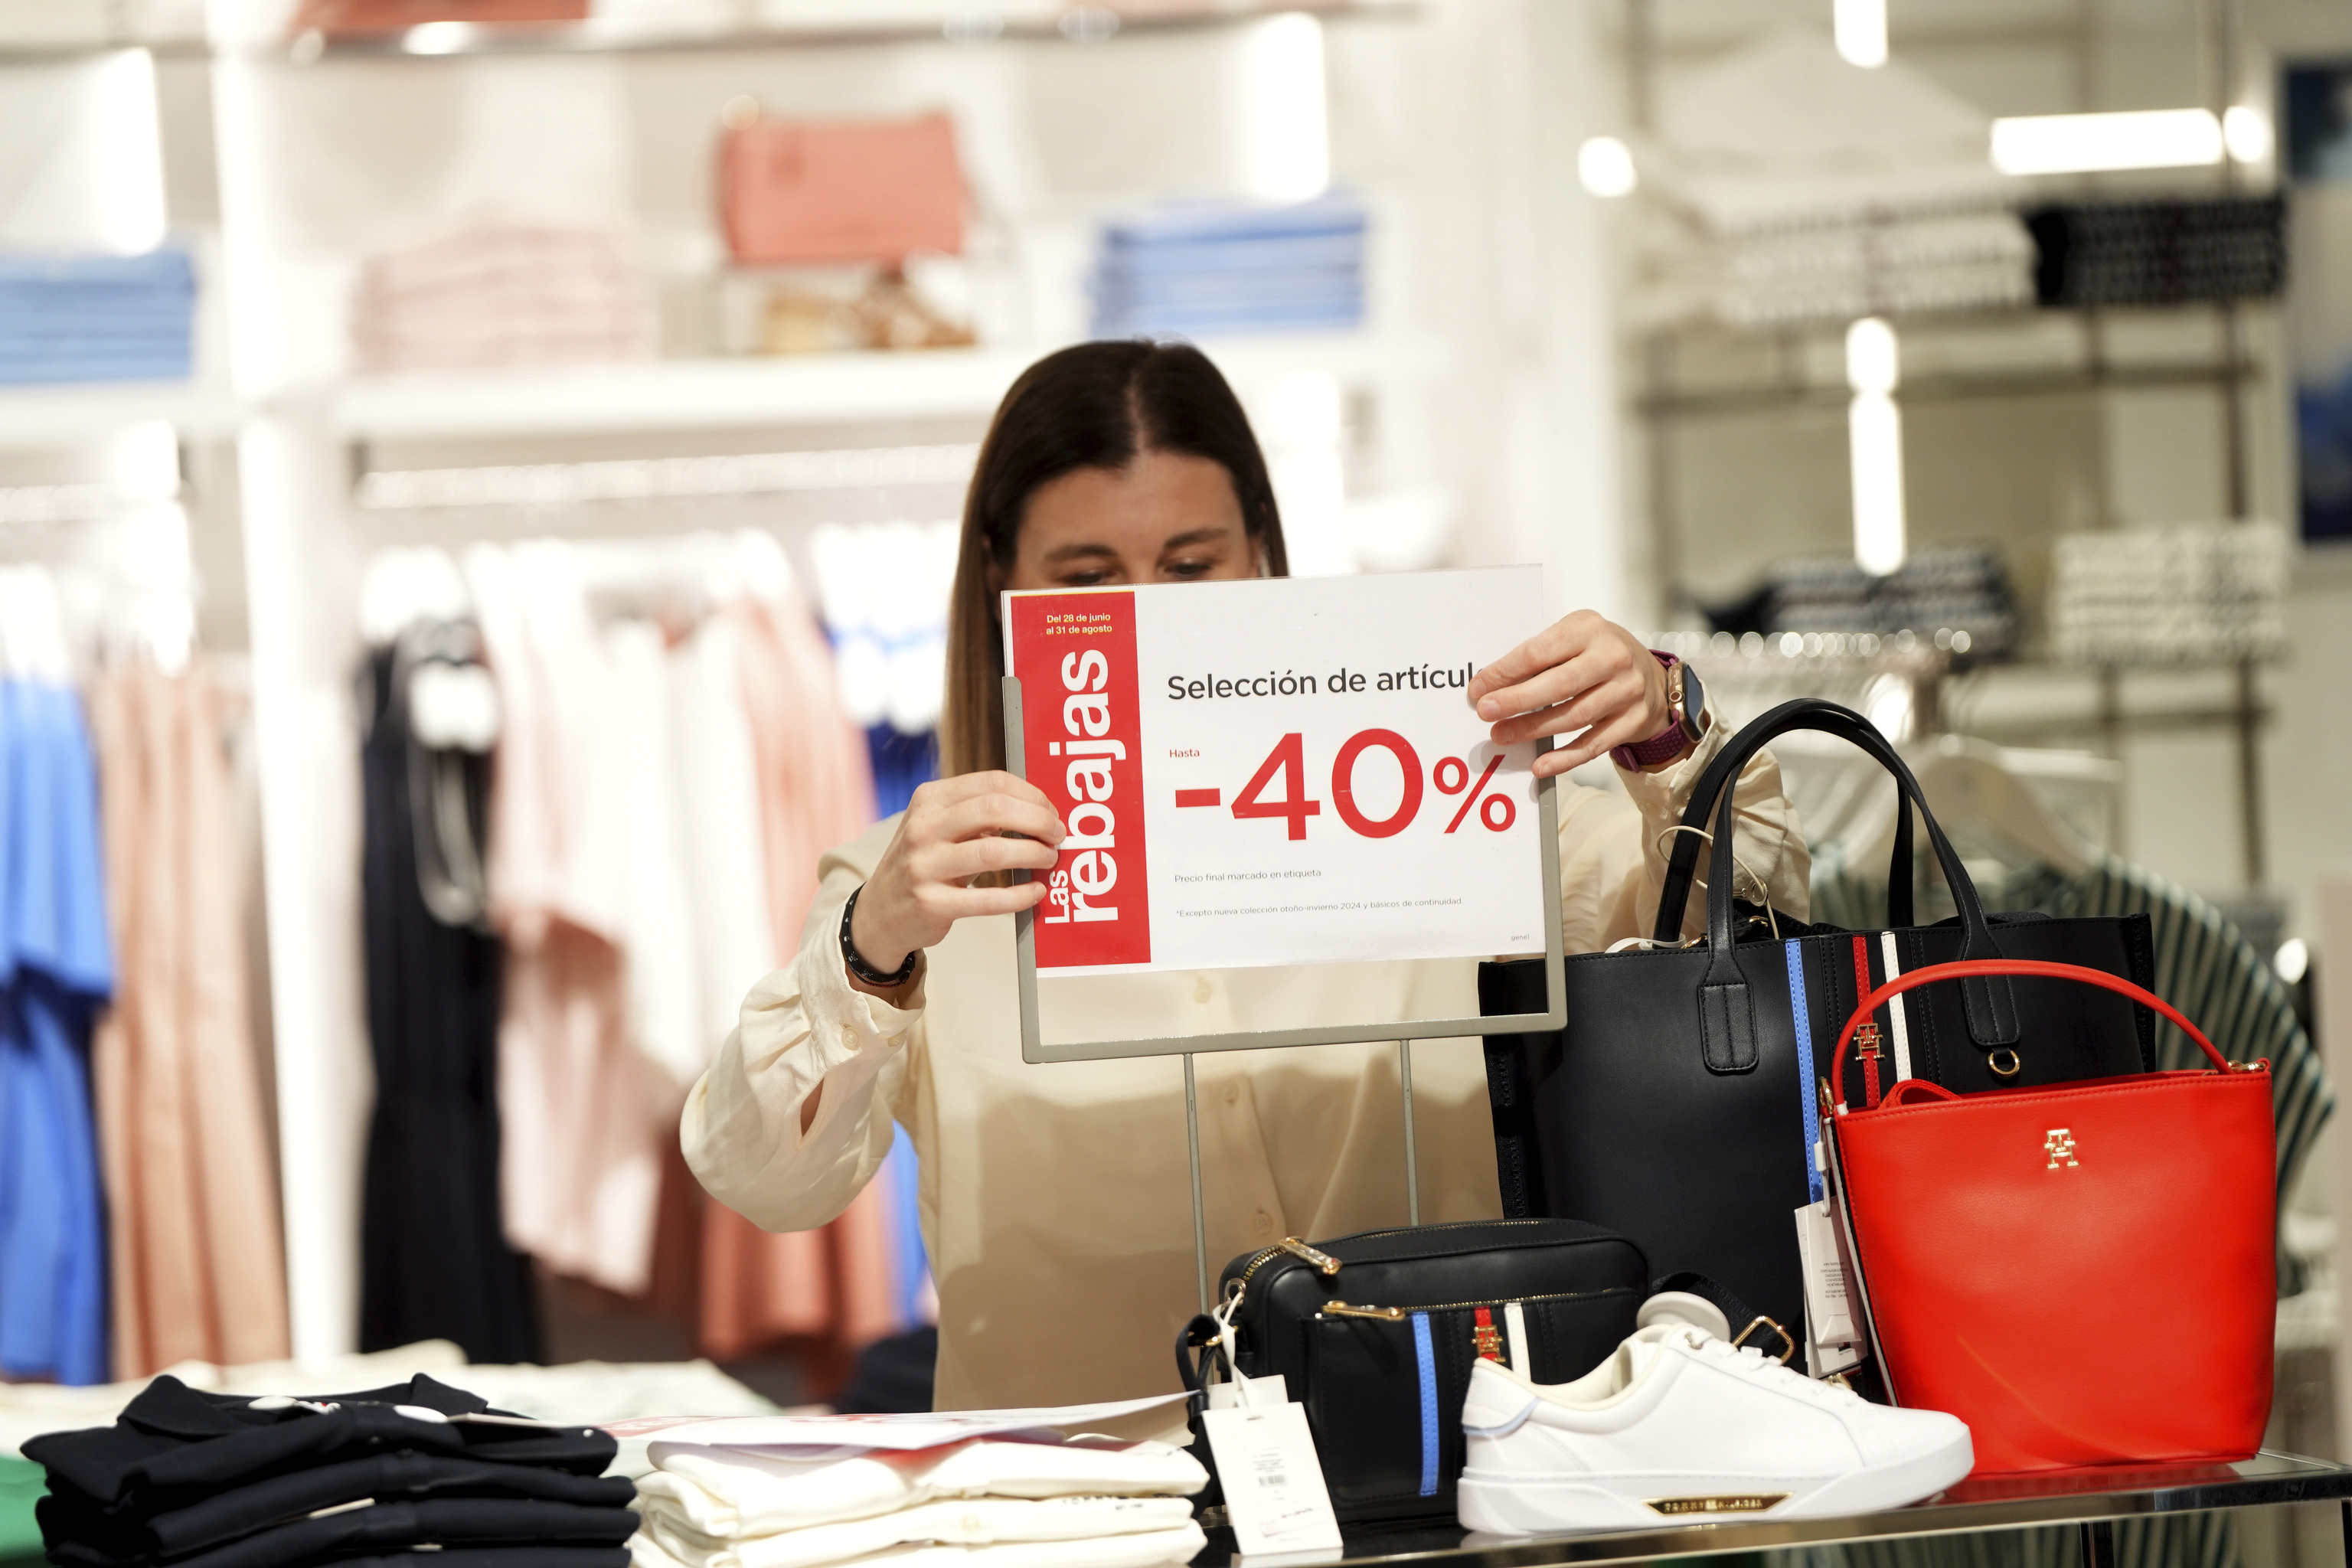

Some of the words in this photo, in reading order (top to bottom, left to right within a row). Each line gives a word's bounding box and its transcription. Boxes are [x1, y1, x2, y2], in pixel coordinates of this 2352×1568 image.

[1047, 614, 1061, 623] Del
[1063, 614, 1074, 622] 28
[1076, 613, 1087, 622] de
[1089, 612, 1111, 623] junio
[1046, 626, 1054, 635] al
[1056, 626, 1066, 634] 31
[1068, 625, 1080, 634] de
[1082, 624, 1112, 635] agosto
[1168, 668, 1318, 700] Selección
[1327, 668, 1367, 694] de
[1377, 662, 1483, 691] artícul
[1169, 748, 1200, 758] Hasta
[1049, 649, 1126, 923] rebajas
[1174, 728, 1517, 841] -40%
[1205, 873, 1225, 881] final
[1227, 871, 1268, 880] marcado
[1283, 869, 1321, 878] etiqueta
[1044, 869, 1070, 924] Las
[1240, 906, 1278, 914] colección
[1279, 903, 1339, 913] otoño-invierno
[1341, 902, 1361, 910] 2024
[1370, 900, 1400, 909] básicos
[1414, 897, 1464, 906] continuidad.
